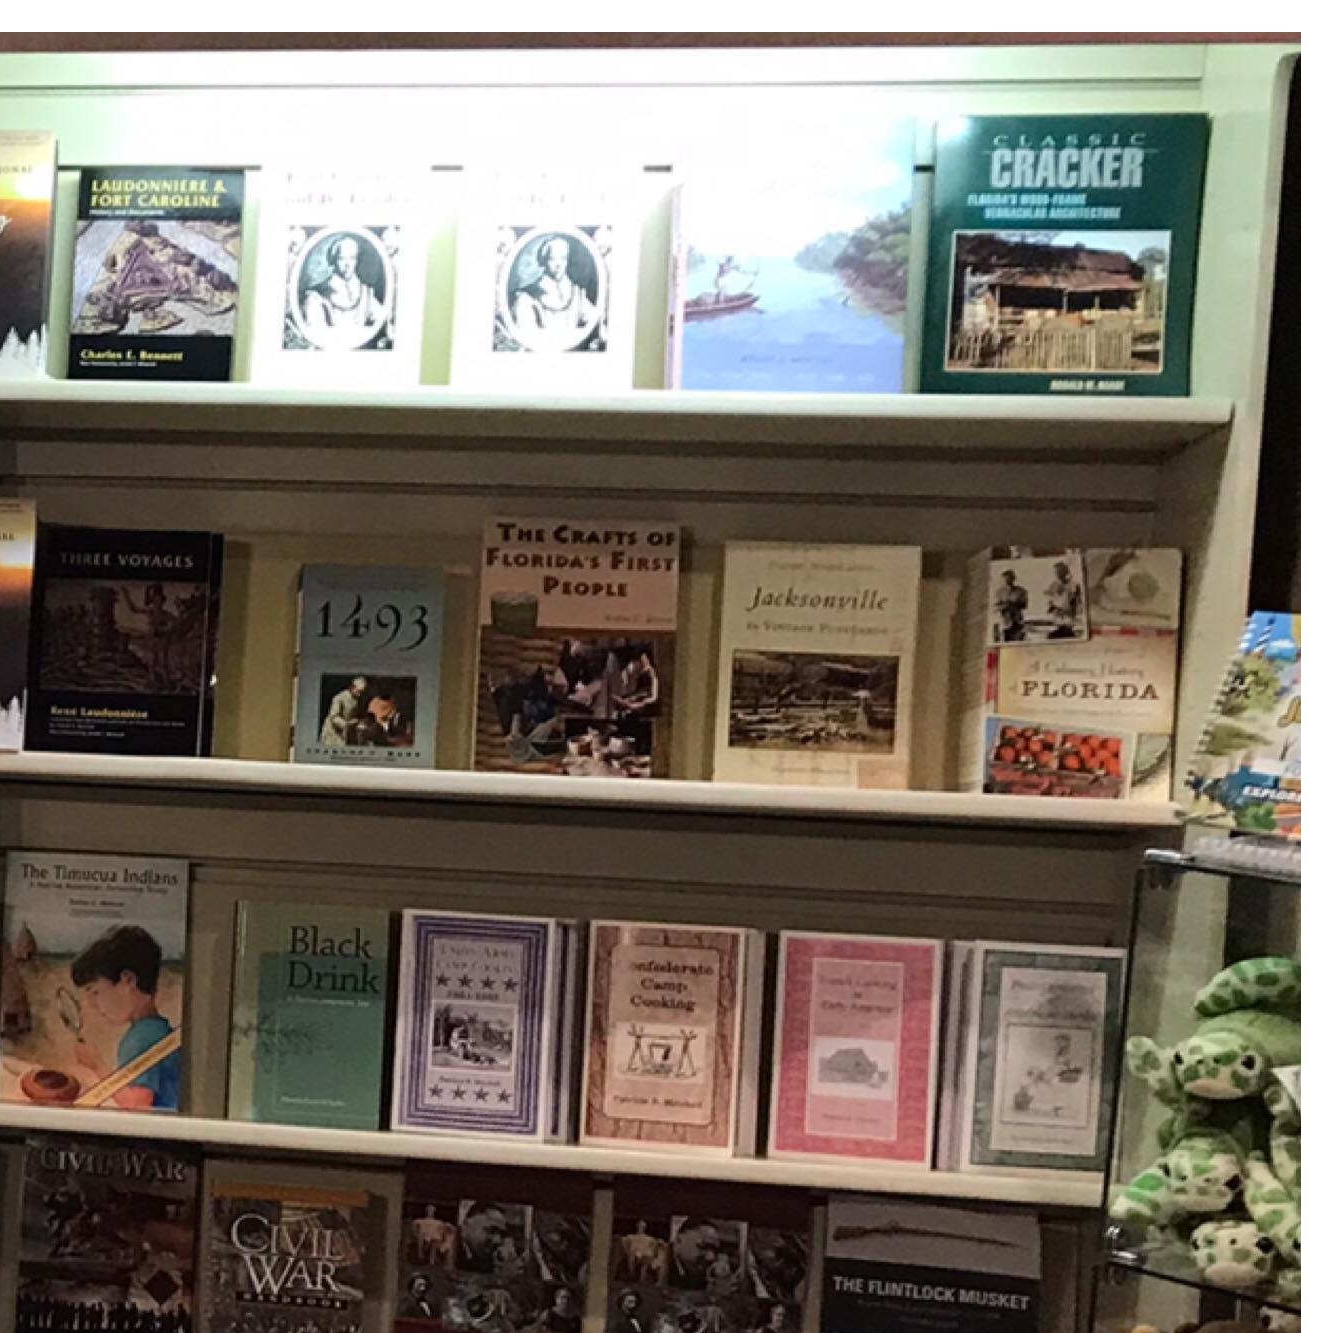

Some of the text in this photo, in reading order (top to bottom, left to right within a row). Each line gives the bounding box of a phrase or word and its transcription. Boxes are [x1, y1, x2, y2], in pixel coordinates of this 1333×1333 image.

[992, 132, 1149, 148] CLASSIC
[991, 146, 1143, 189] CRACKER
[91, 194, 220, 208] FORT CAROLINE
[496, 523, 676, 548] THE CRAFTS OF
[61, 551, 194, 568] THREE VOYAGES
[486, 547, 677, 573] FLORIDA'S FIRST
[542, 573, 629, 600] PEOPLE
[747, 584, 889, 615] Jacksonville
[317, 594, 429, 652] 1493
[1021, 679, 1160, 702] FLORIDA
[21, 863, 179, 887] The Timucua Indians
[290, 926, 372, 959] Black
[287, 961, 380, 993] Drink
[640, 978, 687, 994] Camp
[630, 996, 696, 1012] Cooking
[232, 1213, 343, 1257] CIVIL
[244, 1253, 339, 1295] WAR
[833, 1276, 1030, 1311] THE FLINTLOCK MUSKET
